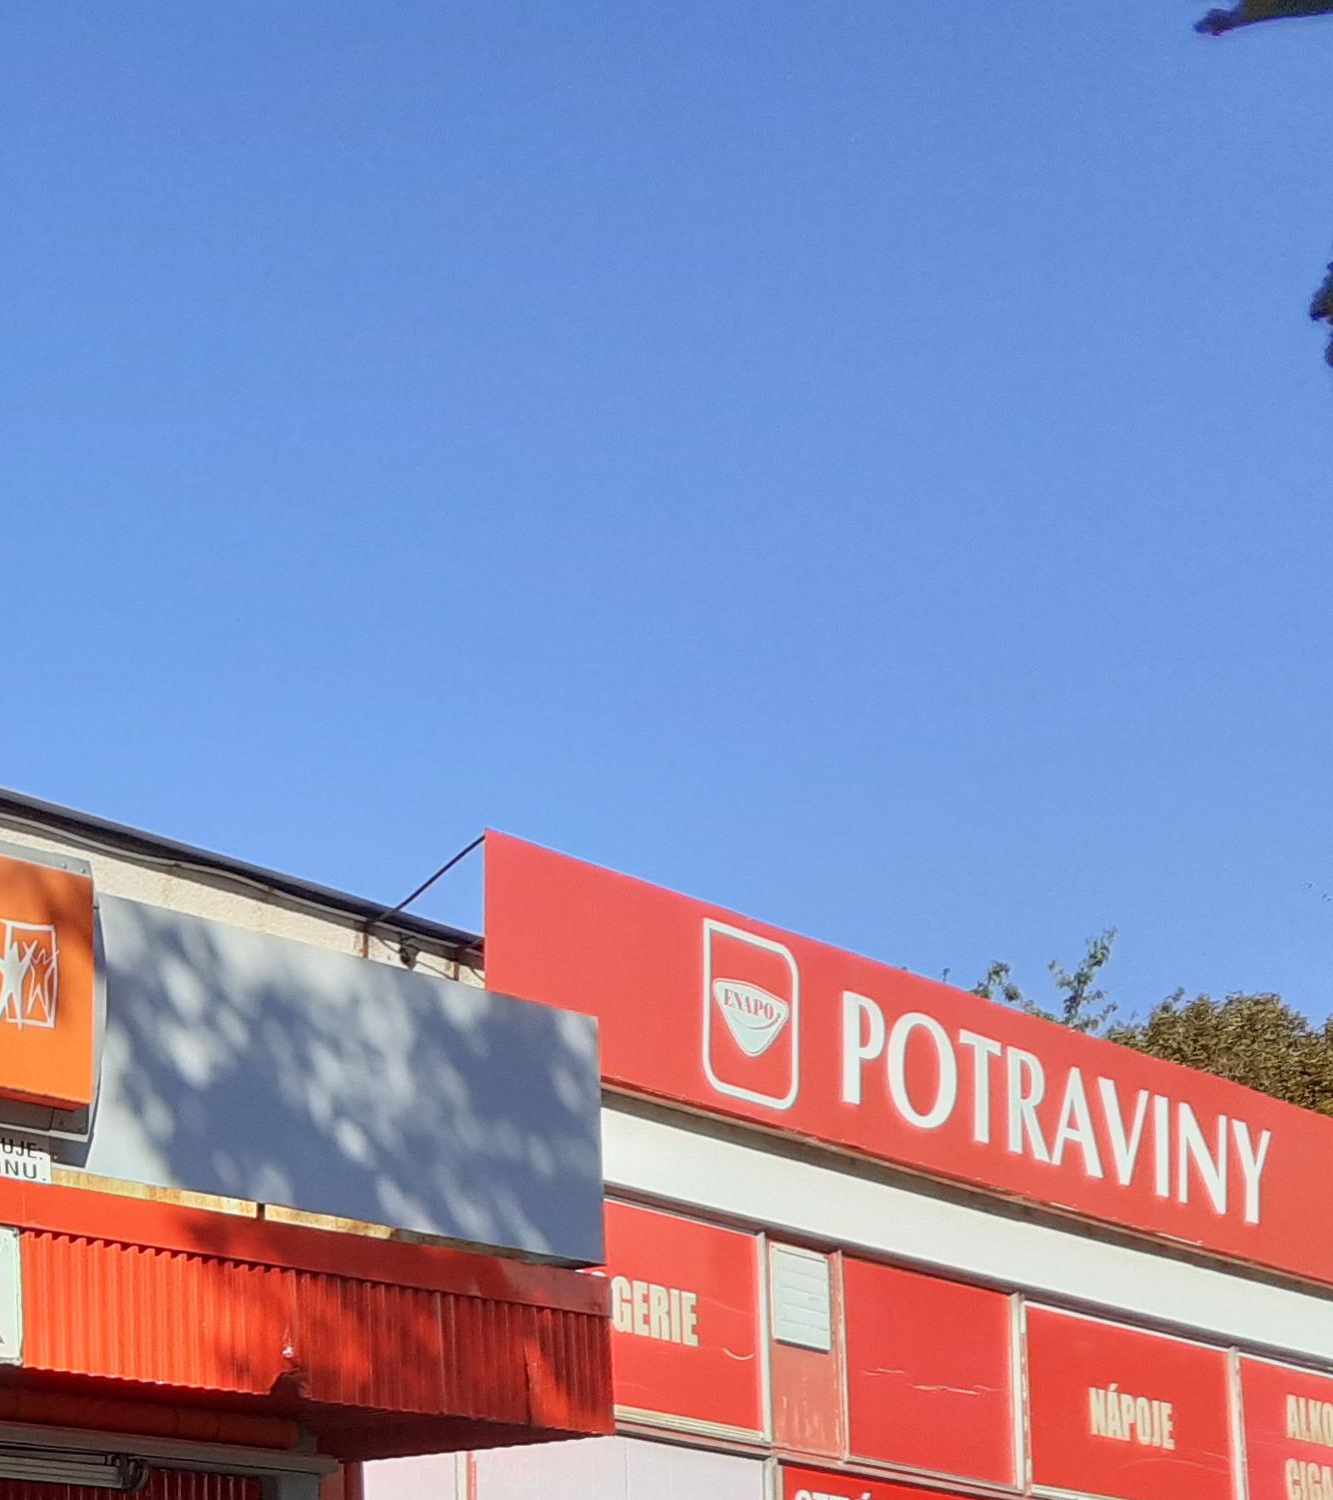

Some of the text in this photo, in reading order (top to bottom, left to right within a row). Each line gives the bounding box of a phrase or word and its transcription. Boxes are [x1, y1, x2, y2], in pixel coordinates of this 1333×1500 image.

[841, 990, 1271, 1225] POTRAVINY
[609, 1274, 700, 1348] GERIE
[1088, 1382, 1175, 1451] NÁPOJE
